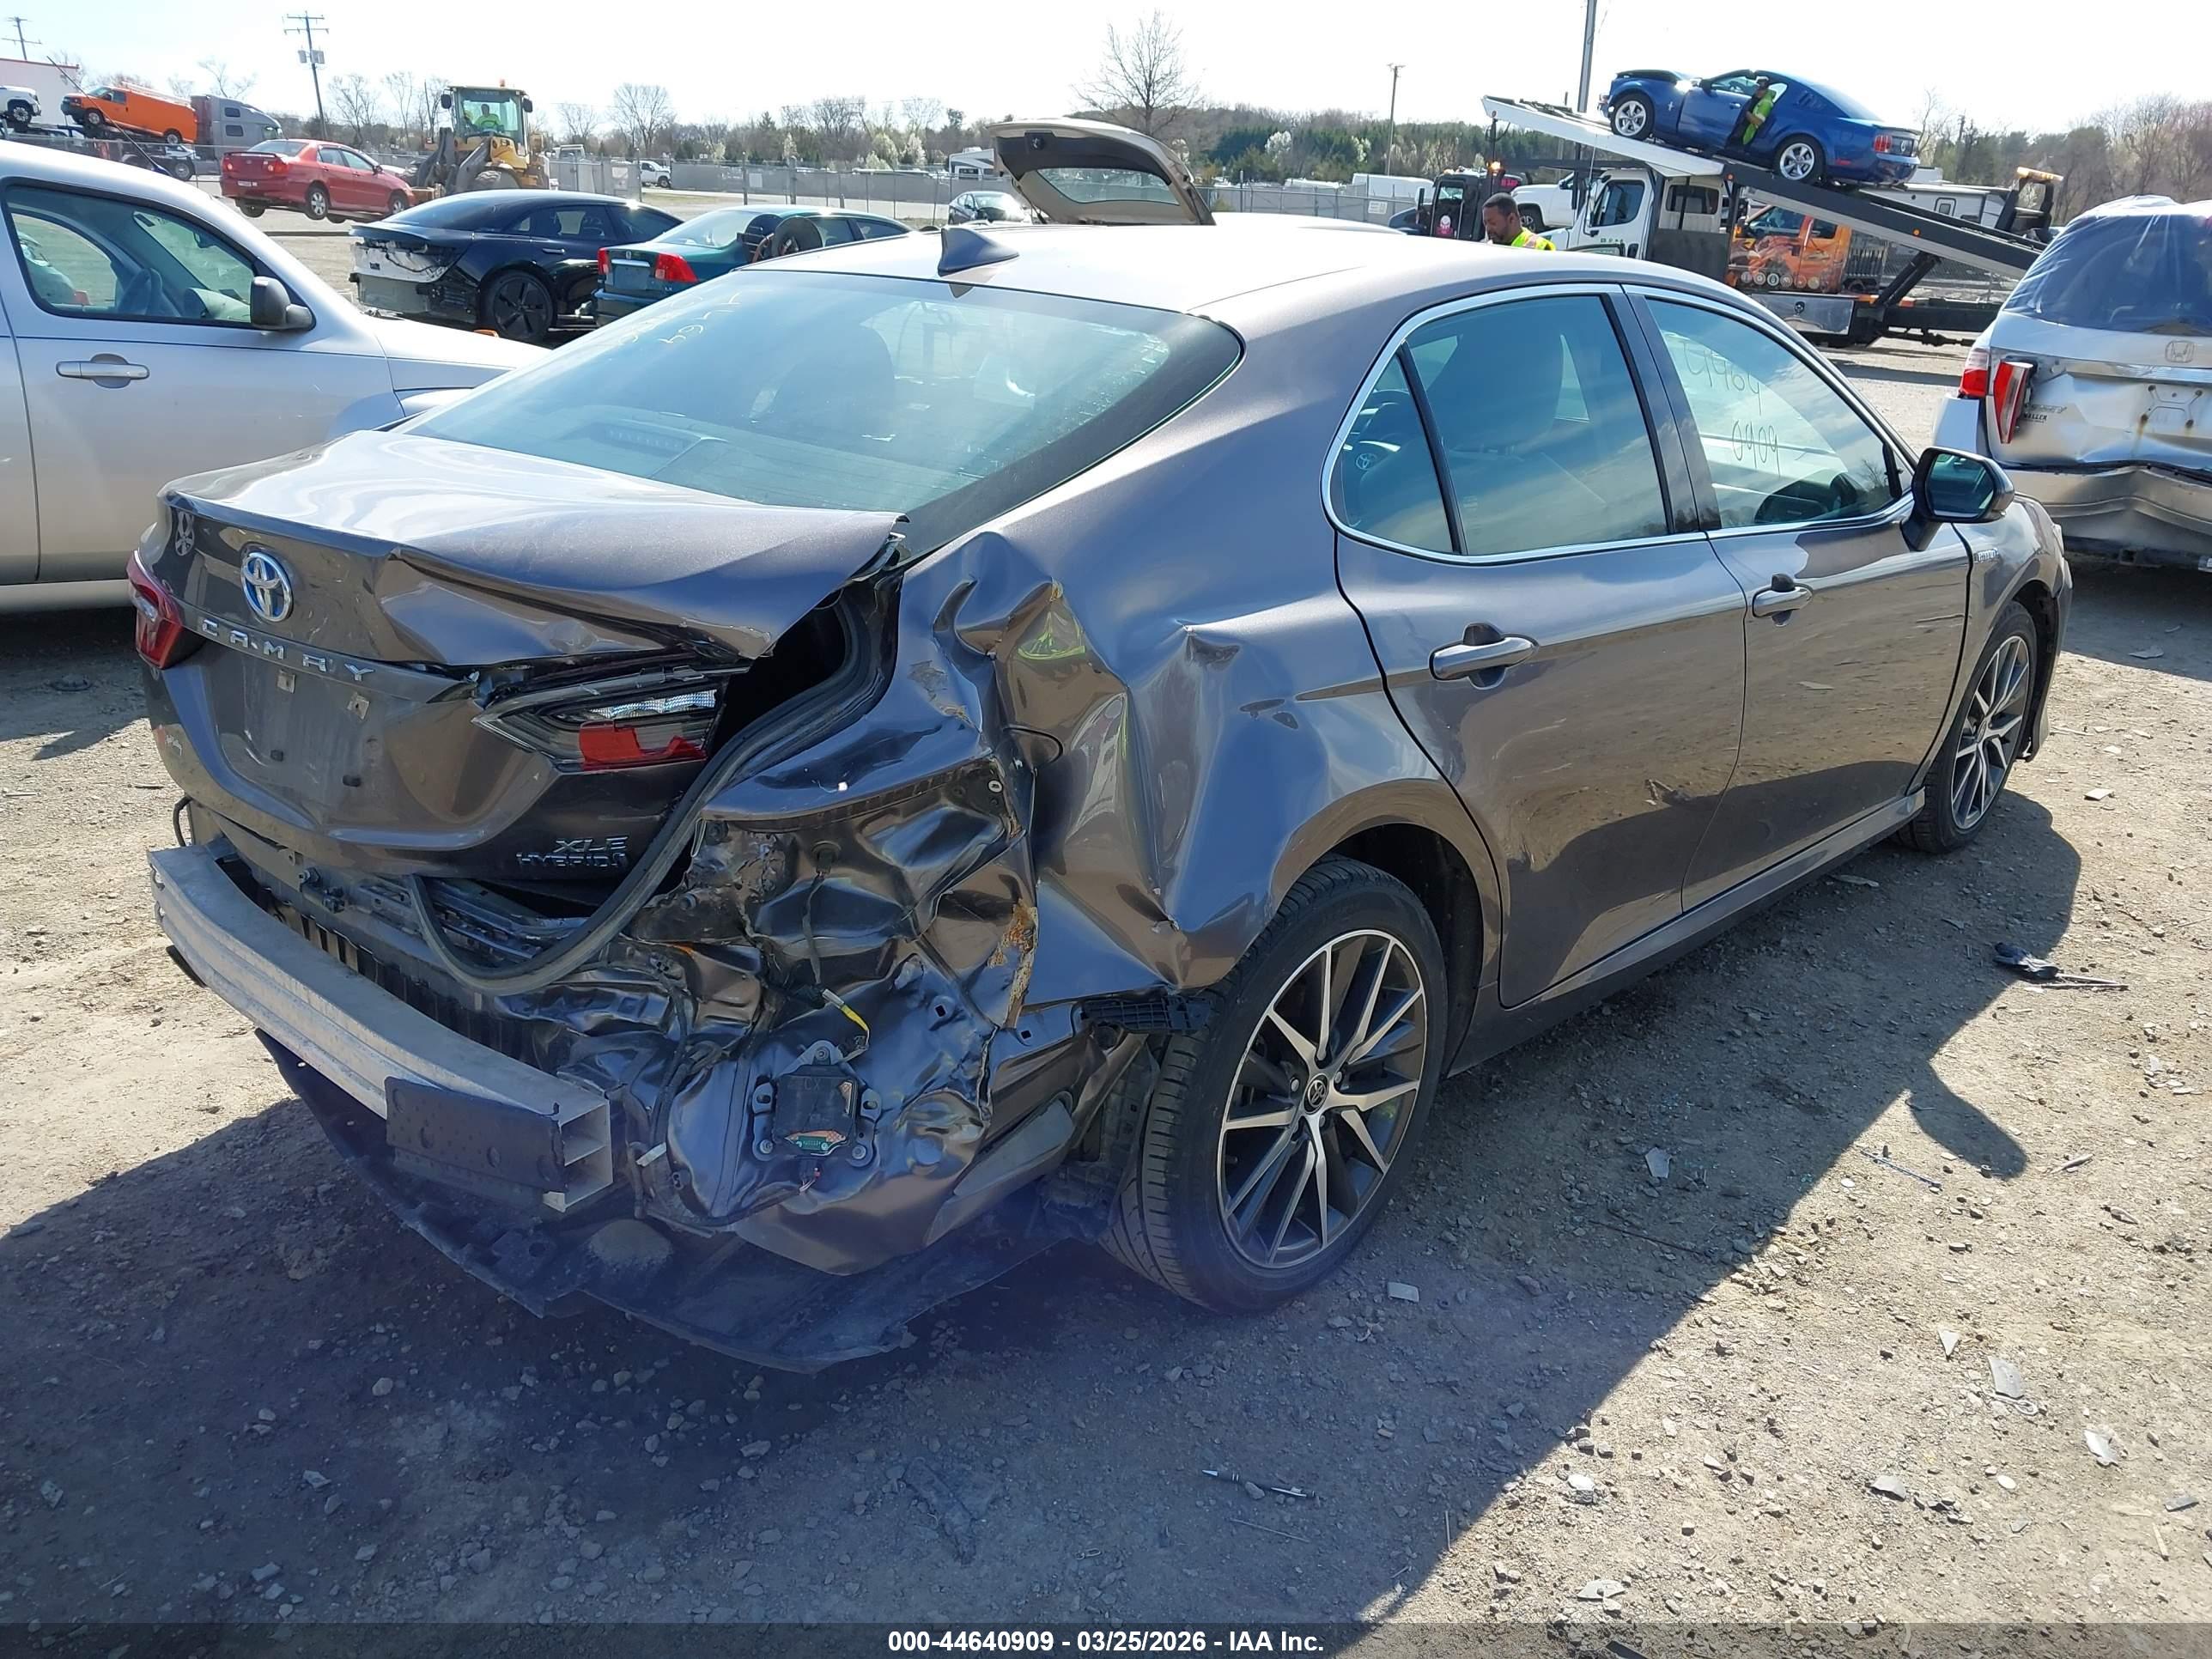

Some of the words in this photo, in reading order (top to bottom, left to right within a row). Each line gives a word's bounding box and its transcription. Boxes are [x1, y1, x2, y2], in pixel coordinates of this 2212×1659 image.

[1683, 343, 1762, 416] 4464
[1731, 419, 1781, 478] 0909
[202, 618, 376, 683] CAMRY
[553, 836, 629, 853] XLE
